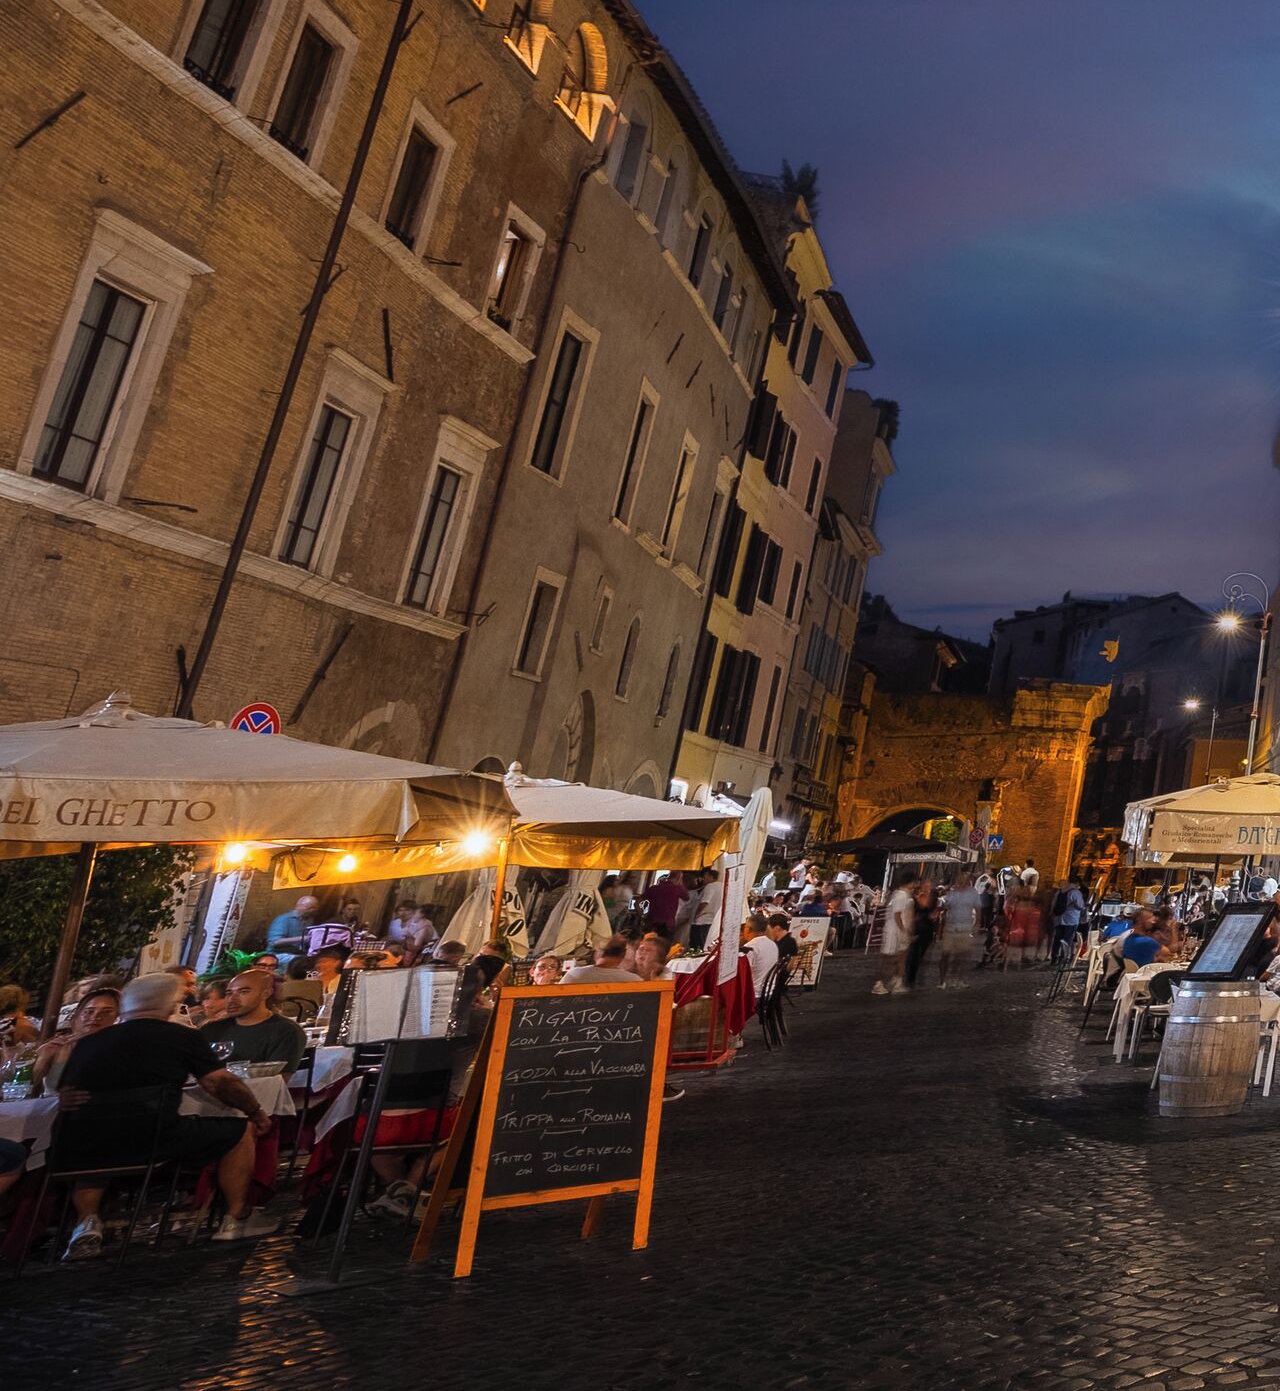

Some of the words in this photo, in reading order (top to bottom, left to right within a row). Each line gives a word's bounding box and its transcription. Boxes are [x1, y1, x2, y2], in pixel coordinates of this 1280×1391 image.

[0, 797, 41, 826] EL
[56, 797, 216, 827] GHETTO
[578, 1025, 642, 1041] PAJATA
[497, 1111, 554, 1129] TRIPPA
[542, 1151, 557, 1160] DI
